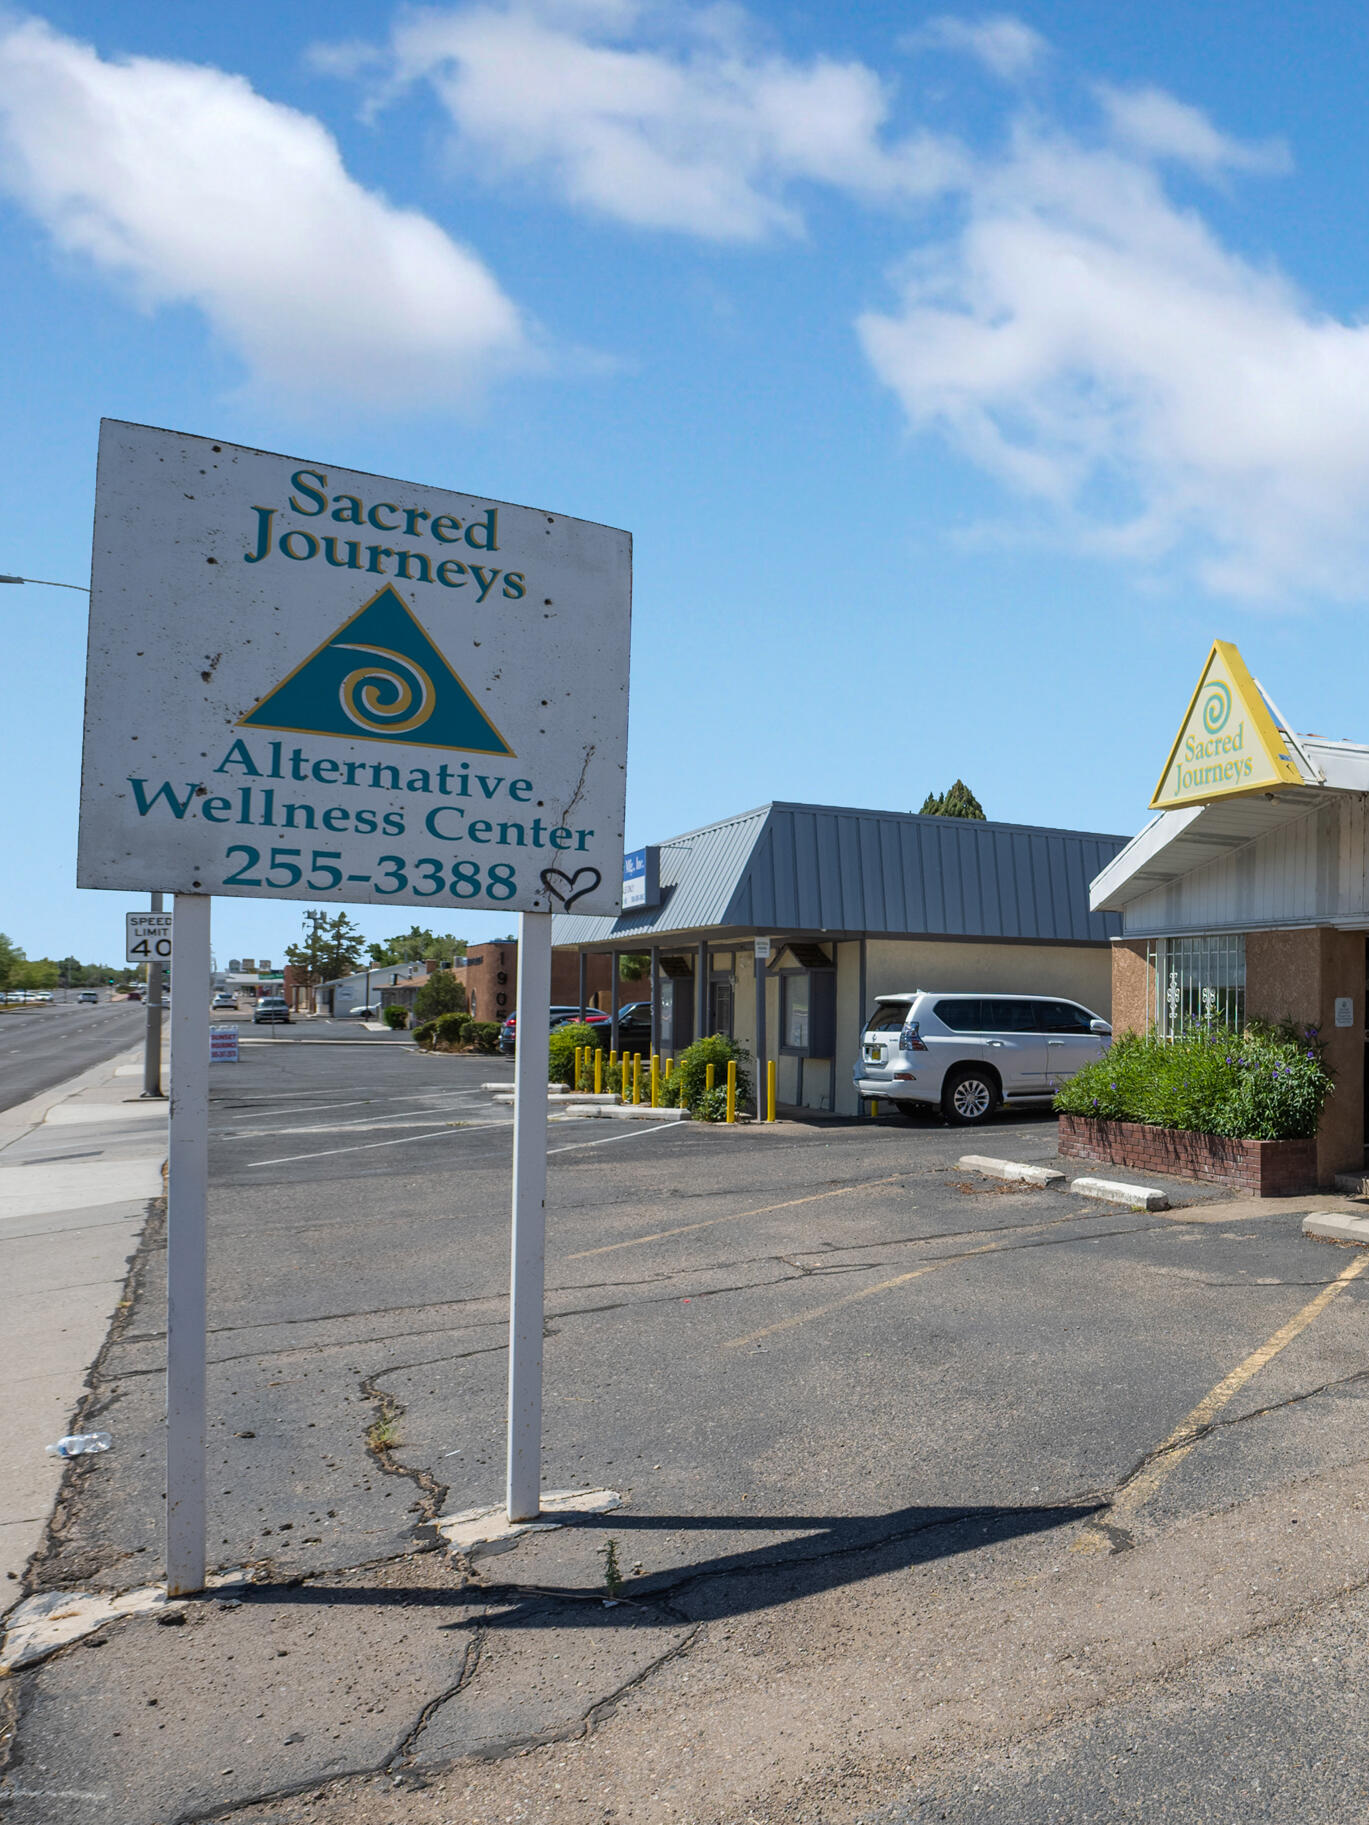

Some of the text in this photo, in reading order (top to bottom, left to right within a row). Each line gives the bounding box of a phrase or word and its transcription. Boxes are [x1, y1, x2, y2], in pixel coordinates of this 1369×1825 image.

[288, 469, 499, 551] Sacred
[244, 504, 527, 603] Journeys
[1184, 720, 1245, 763] Sacred
[213, 738, 534, 803] Alternative
[1174, 756, 1254, 797] Journeys
[127, 777, 595, 852] Wellness Center
[222, 844, 518, 901] 255-3388
[130, 917, 172, 926] SPEED
[135, 928, 168, 937] LIMIT
[130, 938, 172, 957] 40
